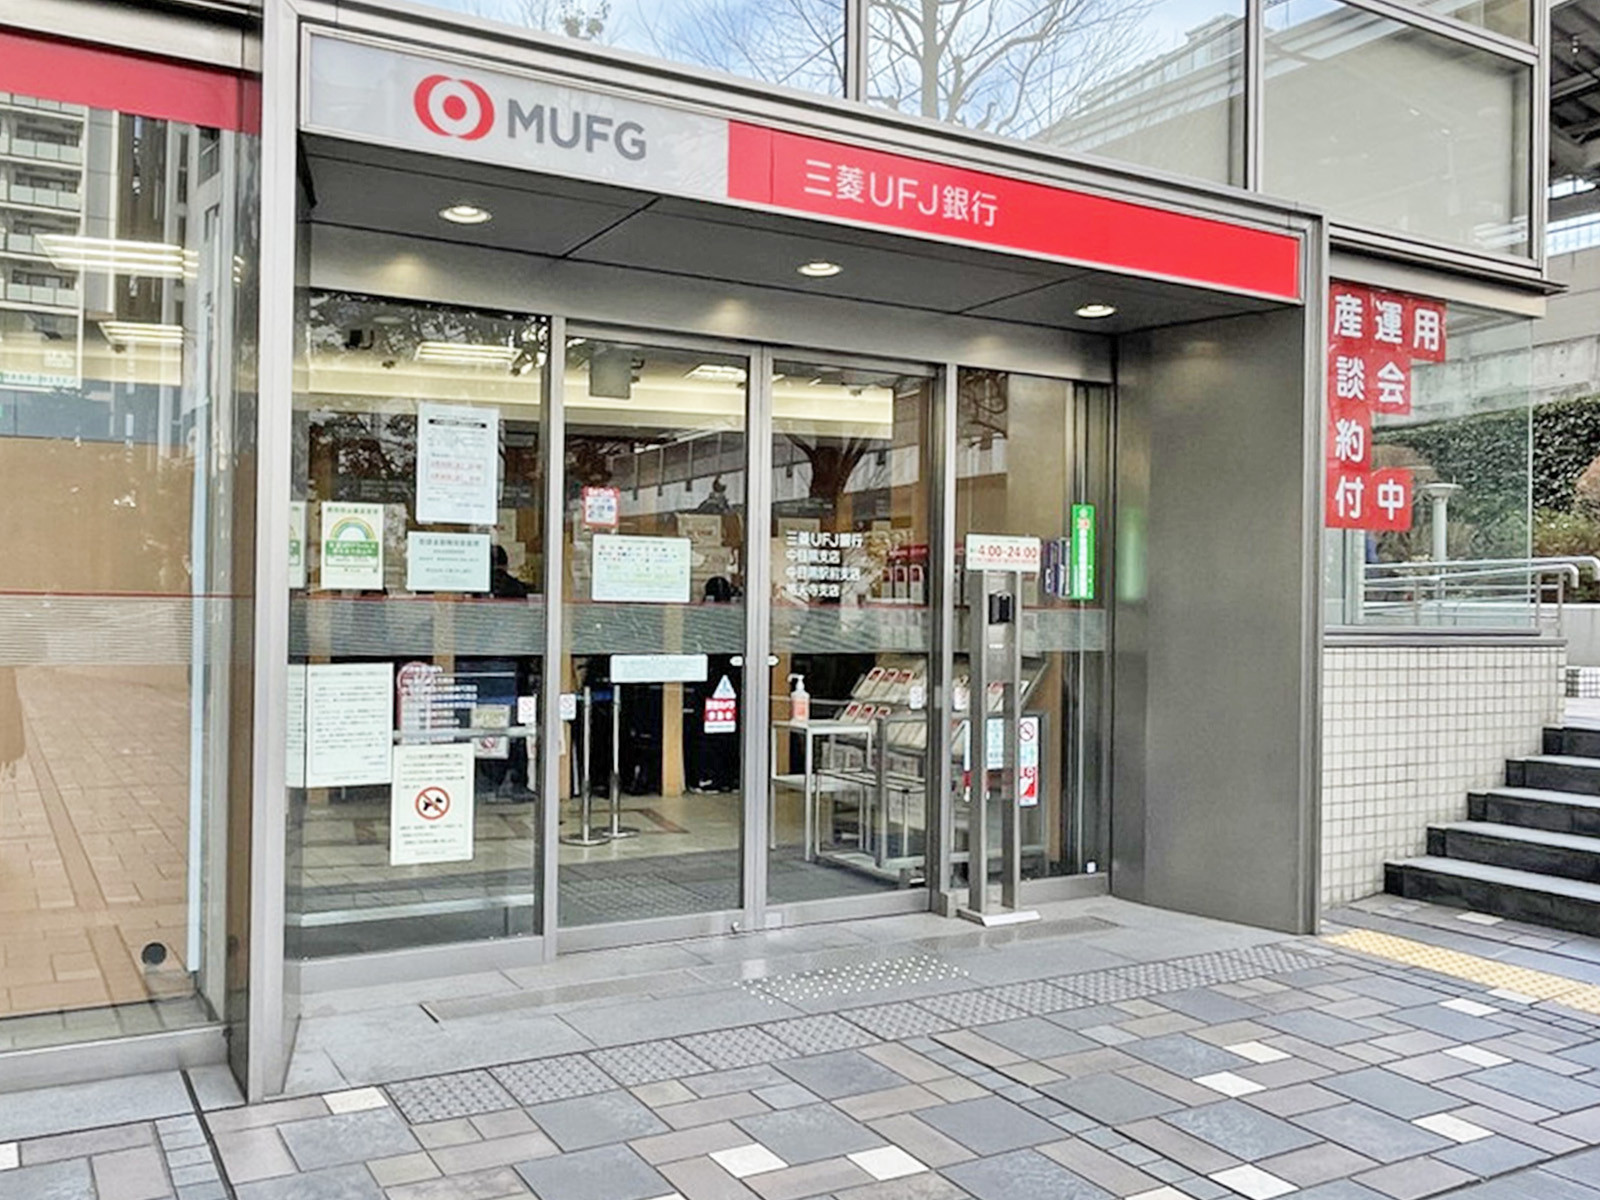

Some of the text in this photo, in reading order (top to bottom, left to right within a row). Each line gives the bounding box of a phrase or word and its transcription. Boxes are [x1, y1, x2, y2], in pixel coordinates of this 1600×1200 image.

[507, 98, 647, 162] MUFG
[804, 158, 999, 228] 三菱UFJ銀行
[1335, 418, 1364, 463] 約
